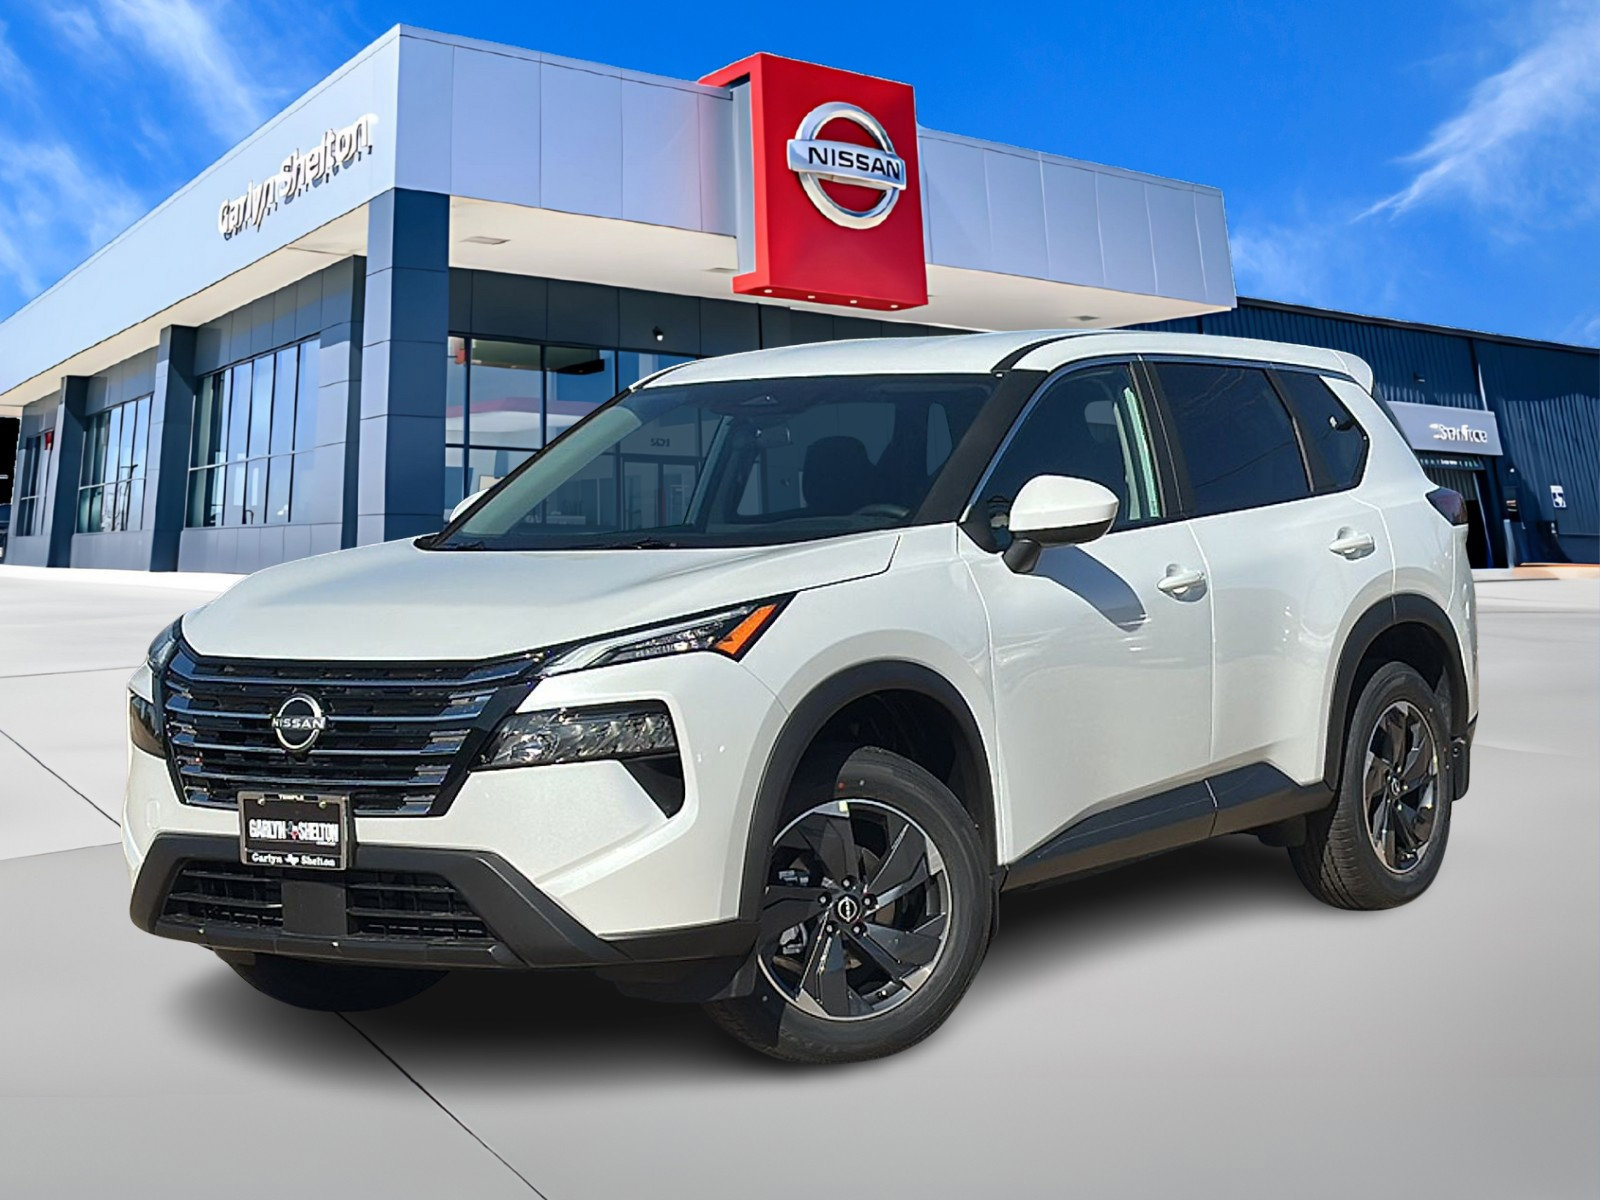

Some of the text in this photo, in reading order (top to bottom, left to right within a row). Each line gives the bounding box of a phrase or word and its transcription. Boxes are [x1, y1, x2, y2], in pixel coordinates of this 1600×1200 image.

[808, 146, 900, 180] NISSAN
[272, 716, 327, 730] NISSAN
[249, 818, 339, 843] GARLYN SHELTON
[301, 854, 336, 867] Shelton
